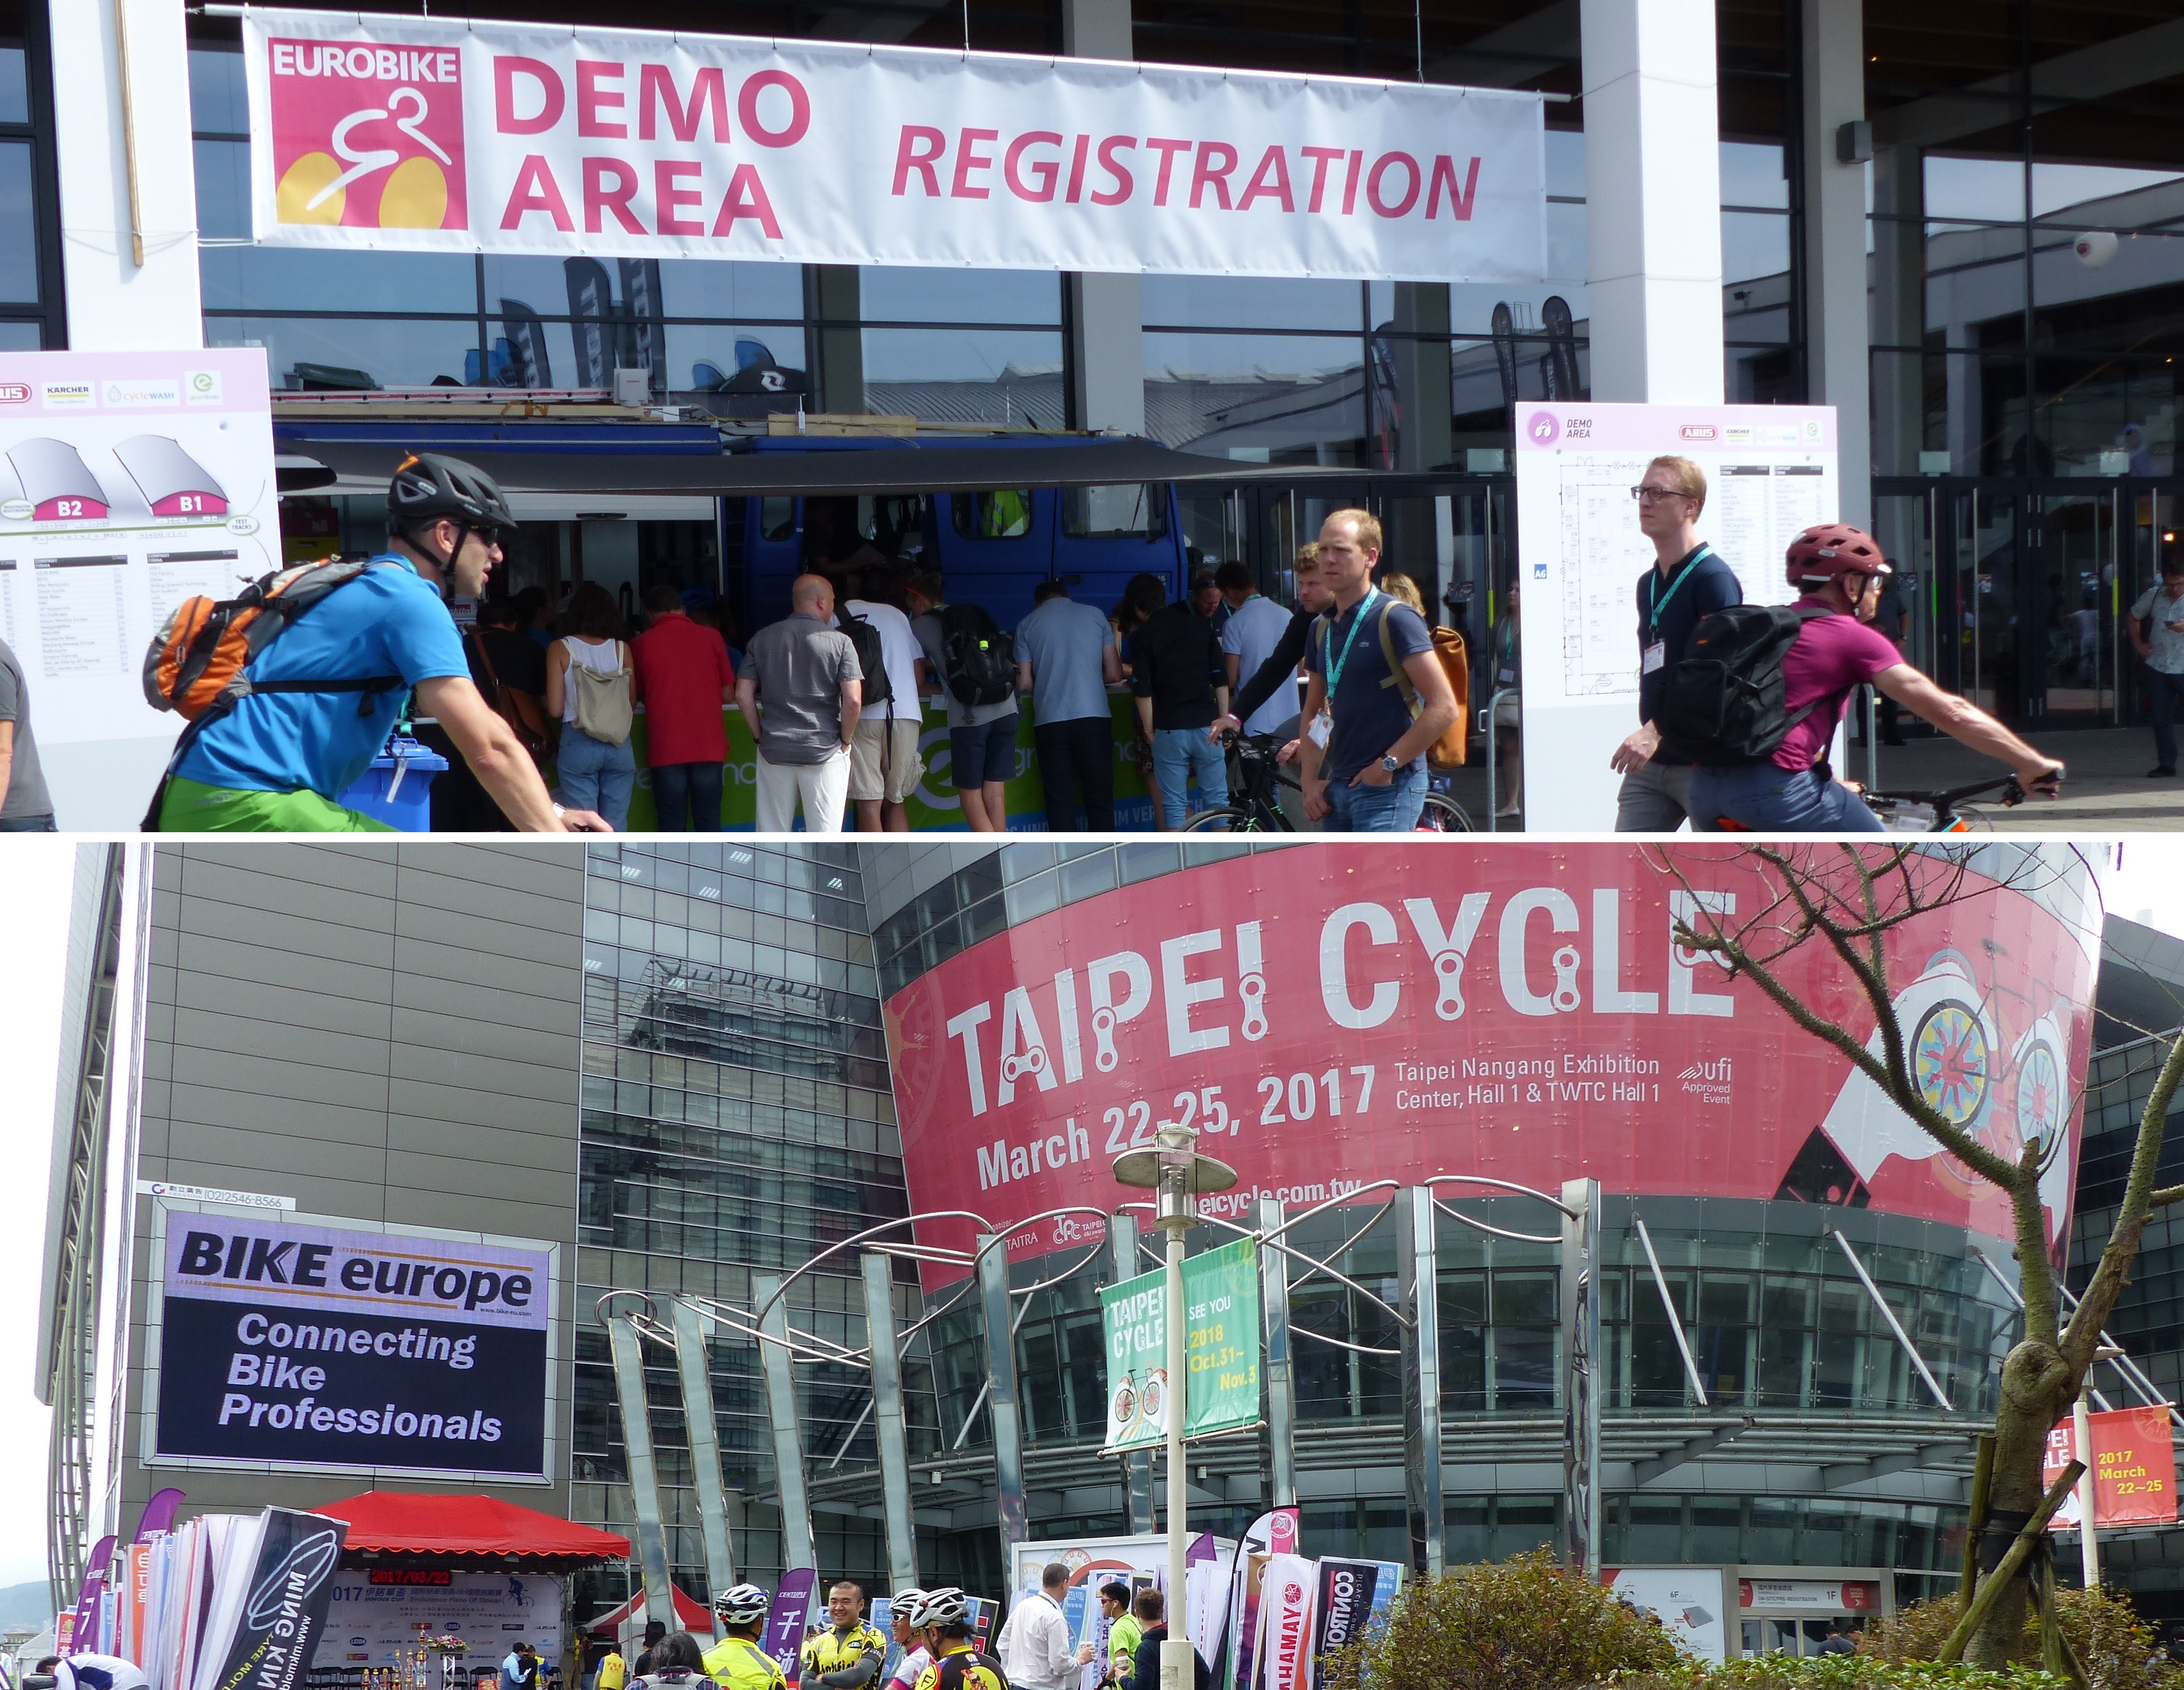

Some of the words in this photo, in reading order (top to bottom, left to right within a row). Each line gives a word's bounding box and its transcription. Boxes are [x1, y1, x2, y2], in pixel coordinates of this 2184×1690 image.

[273, 44, 457, 83] EUROBIKE
[493, 55, 811, 149] DEMO
[890, 124, 1482, 222] REGISTRATION
[499, 154, 784, 240] AREA
[1566, 419, 1592, 428] DEMO
[1566, 429, 1590, 438] AREA
[1683, 428, 1713, 437] ABUS
[58, 501, 82, 516] B2
[180, 496, 202, 511] B1
[1535, 569, 1546, 578] A6
[947, 919, 1271, 1117] TAIPEI
[1318, 886, 1737, 1030] CYCLE
[1394, 1060, 1456, 1085] Taipei
[1462, 1057, 1555, 1080] Nangang
[1563, 1054, 1660, 1075] Exhibition
[1704, 1057, 1732, 1082] ufi
[1395, 1088, 1464, 1110] Center,
[1467, 1083, 1505, 1105] Hall
[1510, 1083, 1519, 1102] 1
[1525, 1083, 1542, 1103] &
[1546, 1081, 1606, 1103] TWTC
[1612, 1081, 1646, 1102] Hall
[1652, 1082, 1660, 1102] 1
[1682, 1081, 1731, 1095] Approved
[1702, 1092, 1731, 1105] Event
[976, 1115, 1090, 1193] March
[1102, 1086, 1240, 1155] 22-25,
[1256, 1064, 1375, 1129] 2017
[204, 1189, 282, 1208] (02)2546-8566
[1082, 1219, 1103, 1231] TAIPEI
[1005, 1232, 1039, 1251] TAITRA
[178, 1231, 334, 1288] BIKE
[340, 1257, 532, 1311] europe
[1110, 1286, 1164, 1328] TAIPEI
[1189, 1303, 1206, 1321] SEE
[1210, 1295, 1231, 1315] YOU
[237, 1313, 476, 1370] Connecting
[1113, 1317, 1163, 1359] CYCLE
[1189, 1324, 1224, 1349] 2018
[227, 1353, 326, 1391] Bike
[1220, 1365, 1256, 1391] Nov.3
[218, 1393, 502, 1443] Professionals
[2098, 1450, 2133, 1466] 2017
[2099, 1466, 2146, 1480] March
[2117, 1479, 2163, 1495] 22~25
[371, 1570, 449, 1584] 2017/03/22
[1826, 1591, 1836, 1600] 1F
